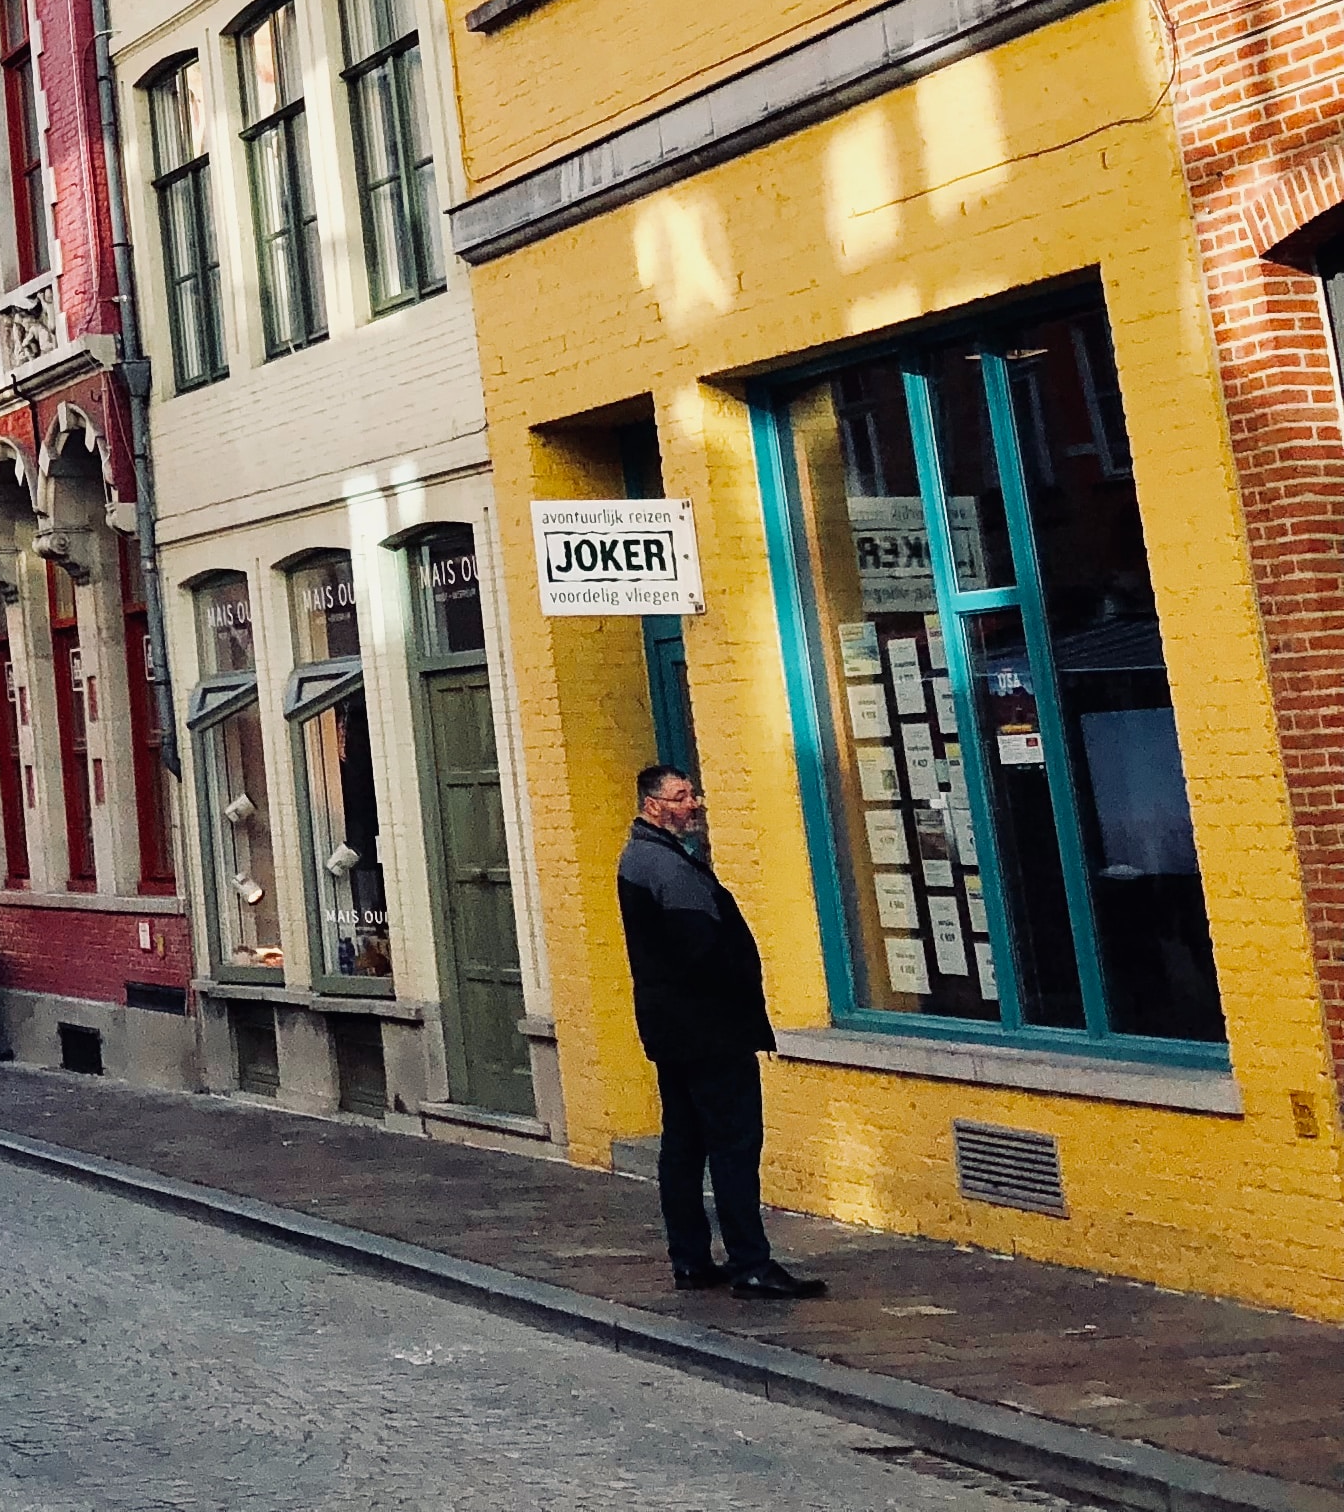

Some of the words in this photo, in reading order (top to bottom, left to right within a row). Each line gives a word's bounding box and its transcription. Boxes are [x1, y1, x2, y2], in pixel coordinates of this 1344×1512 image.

[541, 509, 624, 527] avontuurlijk
[628, 511, 672, 525] reizen
[555, 539, 668, 573] JOKER
[419, 559, 457, 590] MAIS
[461, 555, 479, 582] OU
[303, 582, 334, 612] MAIS
[337, 582, 356, 608] OU
[549, 588, 620, 606] voordelig
[625, 587, 680, 606] vliegen
[207, 601, 234, 628] MAIS
[236, 600, 253, 625] OU
[997, 672, 1022, 689] USA
[325, 909, 360, 924] MAIS
[364, 910, 388, 925] OUI
